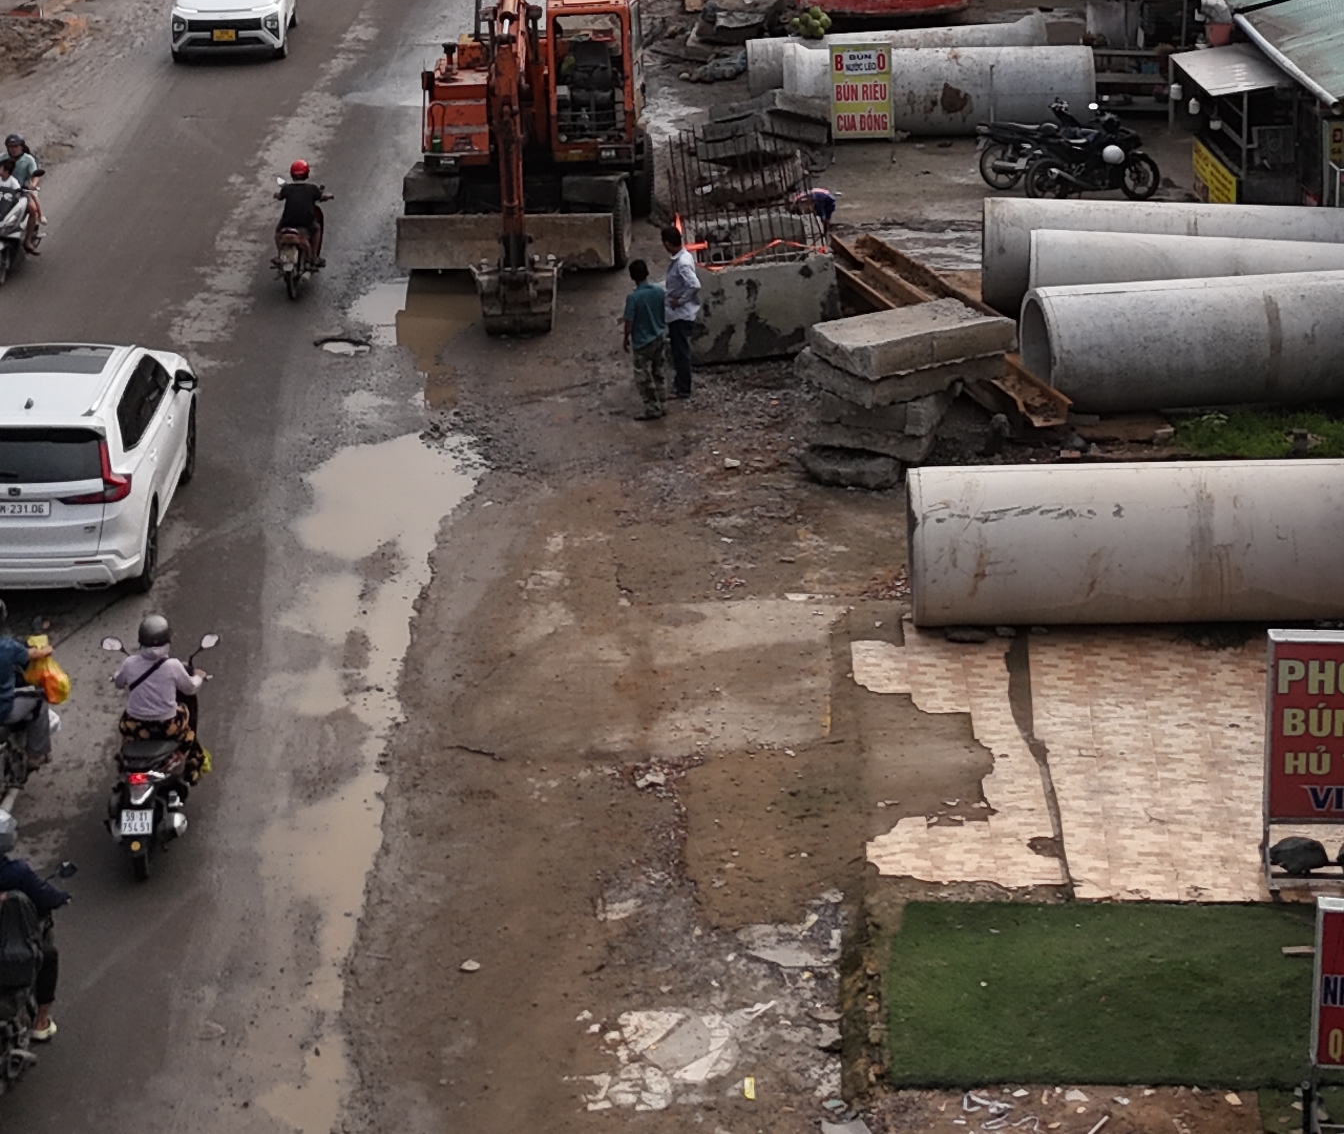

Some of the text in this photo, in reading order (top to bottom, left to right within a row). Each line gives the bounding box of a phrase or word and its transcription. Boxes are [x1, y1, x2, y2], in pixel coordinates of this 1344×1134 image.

[835, 80, 887, 102] BÚN RIÊU
[837, 107, 888, 132] CUA ĐỒNG
[1284, 744, 1332, 775] HỦ
